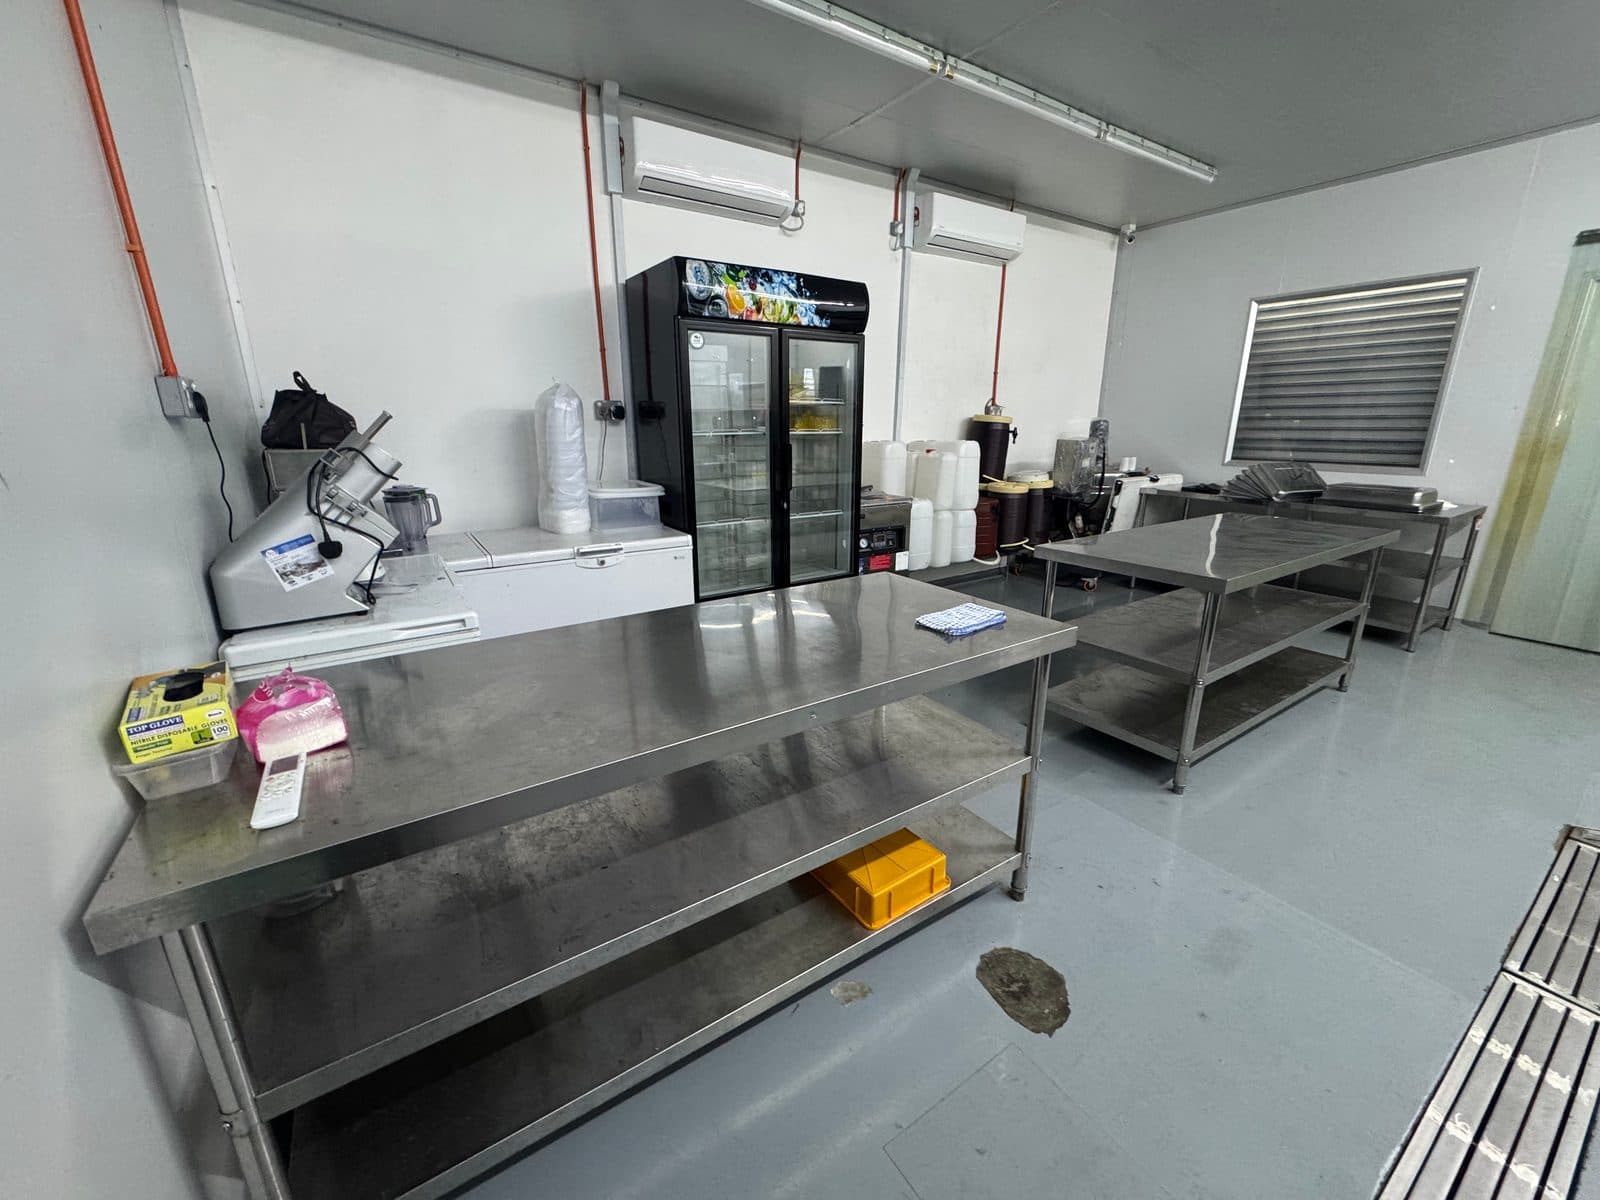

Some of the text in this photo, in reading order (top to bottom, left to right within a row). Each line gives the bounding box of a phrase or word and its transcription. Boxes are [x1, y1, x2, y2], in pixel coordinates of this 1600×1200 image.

[127, 725, 148, 734] TOP
[150, 716, 182, 729] GLOVE
[131, 736, 155, 746] NITRILE
[157, 726, 198, 739] DISPOSABLE
[201, 718, 228, 730] GLOVES
[212, 725, 228, 734] 100
